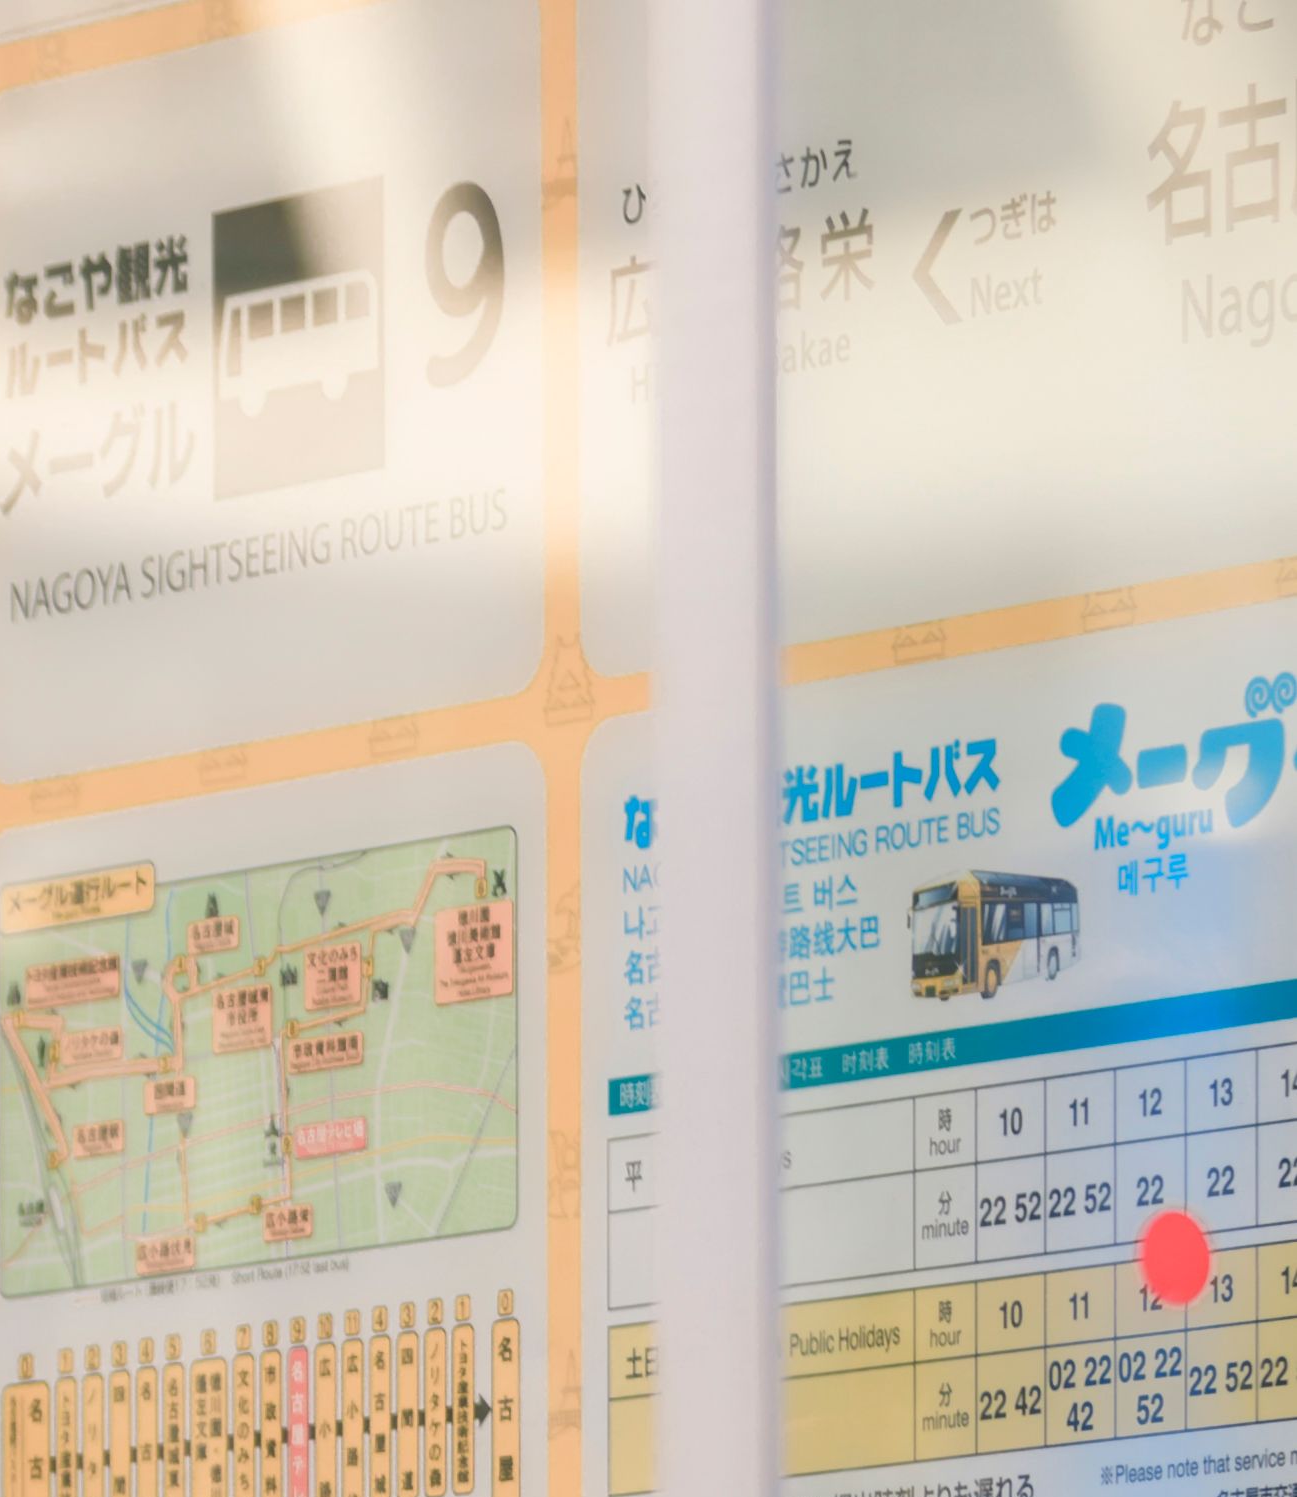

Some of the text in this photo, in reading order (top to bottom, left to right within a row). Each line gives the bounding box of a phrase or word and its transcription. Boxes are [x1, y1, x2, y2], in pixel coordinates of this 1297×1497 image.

[1146, 79, 1297, 245] 名古
[969, 190, 1057, 246] つぎは
[5, 233, 190, 327] なごや観光
[425, 180, 505, 390] 9
[970, 267, 1044, 318] Next
[5, 308, 190, 399] ルートバス
[0, 400, 195, 518] メーグル
[10, 487, 509, 624] NAGOYA SIGHTSEEING ROUTE BUS
[1050, 672, 1297, 829] メーグ
[875, 807, 1001, 854] ROUTE BUS
[8, 870, 148, 913] メーグル運行ルート
[813, 873, 858, 911] 버스
[1118, 853, 1191, 897] 메구루
[908, 1037, 957, 1066] 時刻表
[936, 1108, 953, 1132] 時
[998, 1078, 1235, 1138] 10 11 12 13
[928, 1135, 962, 1159] hour
[937, 1190, 953, 1216] 分
[979, 1164, 1236, 1229] 22 52 22 52 22 22
[921, 1216, 970, 1241] minute
[936, 1300, 953, 1324] 時
[998, 1299, 1024, 1330] 10
[1068, 1291, 1092, 1322] 11
[1208, 1274, 1235, 1304] 13
[789, 1322, 901, 1358] Public Holidays
[928, 1325, 962, 1349] hour
[979, 1355, 1290, 1422] 22 42 22 52 22
[1048, 1345, 1184, 1392] 02 22 02 22
[937, 1381, 953, 1408] 分
[1065, 1392, 1165, 1434] 42 52
[373, 1349, 387, 1496] 名古屋城
[921, 1408, 970, 1434] minute
[1167, 1458, 1199, 1481] note
[1203, 1454, 1231, 1476] that
[1234, 1448, 1286, 1473] service
